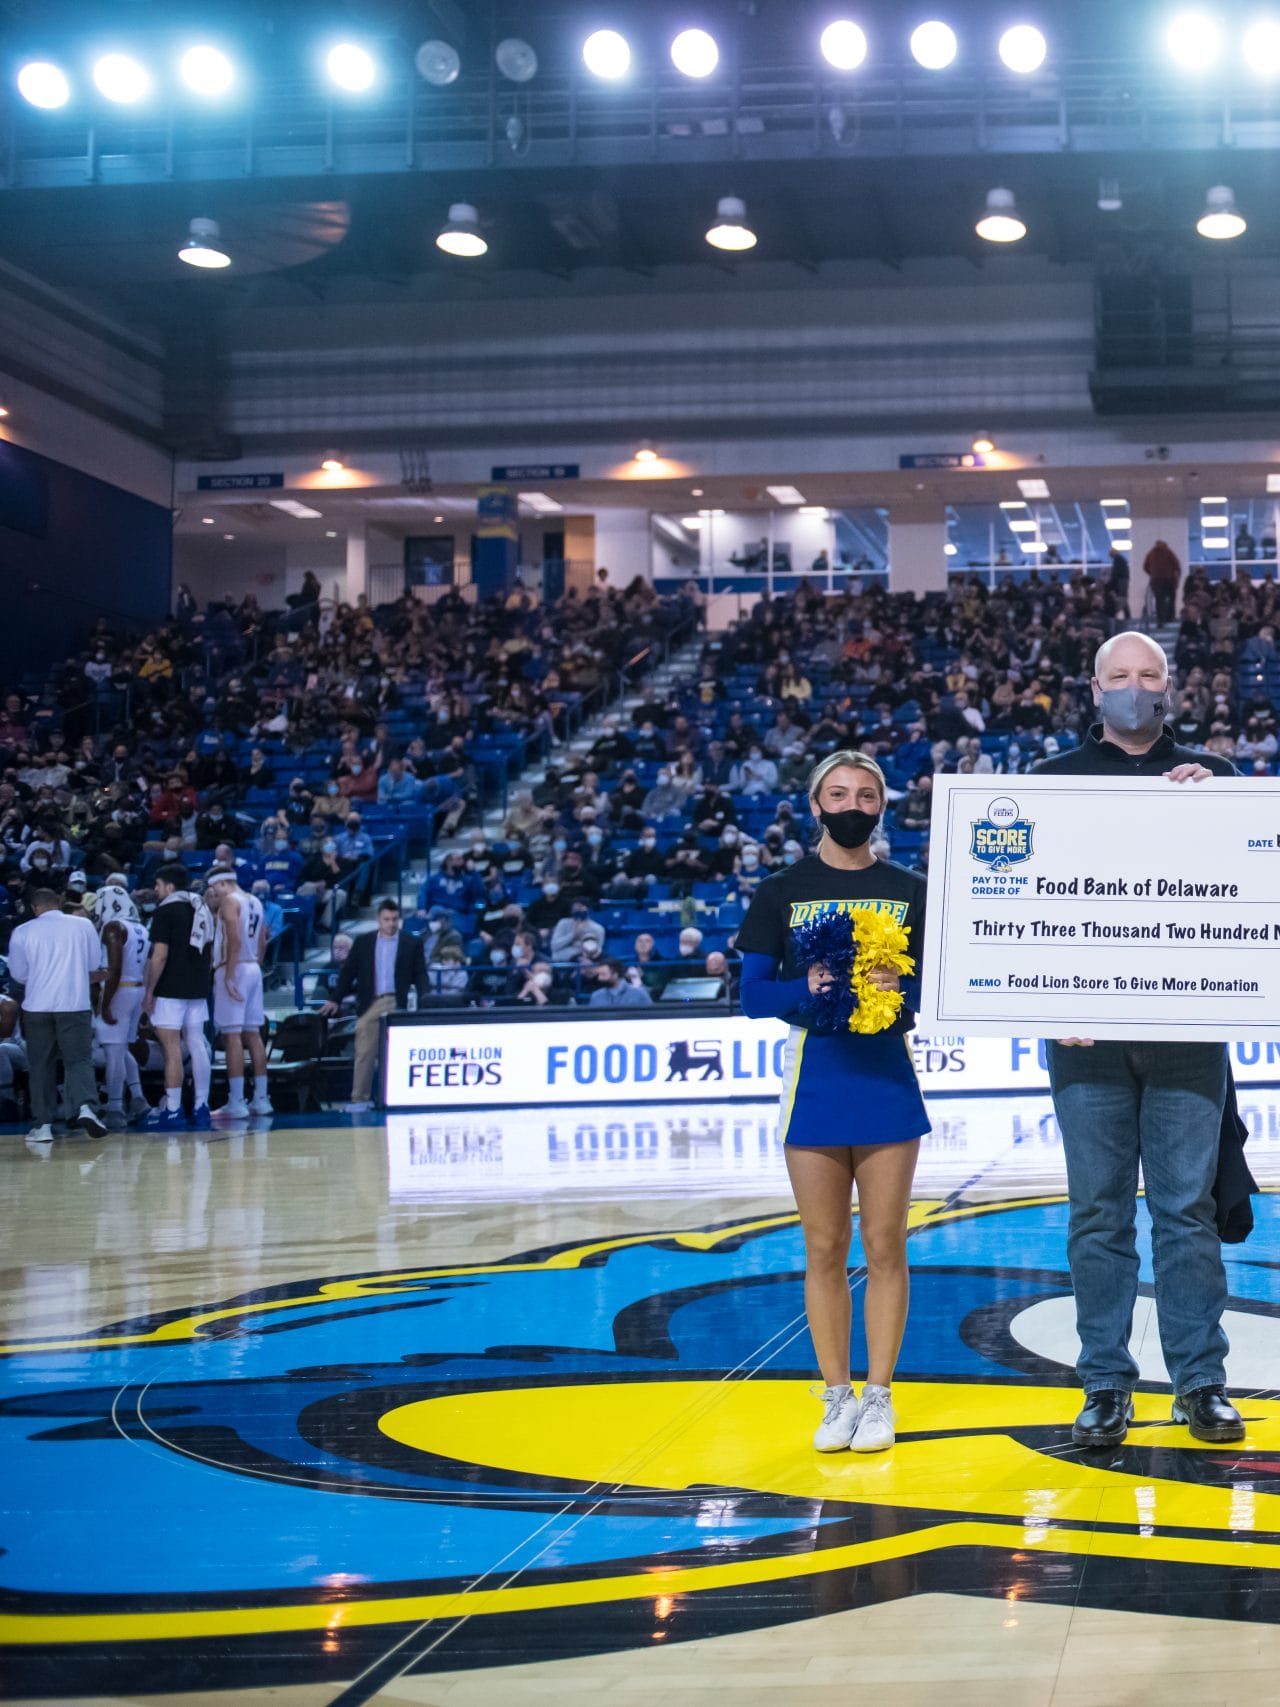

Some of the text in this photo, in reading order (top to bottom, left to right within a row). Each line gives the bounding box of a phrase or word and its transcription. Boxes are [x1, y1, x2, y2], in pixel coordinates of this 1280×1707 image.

[976, 828, 1027, 846] SCORE
[1247, 839, 1273, 848] DATE
[977, 845, 1027, 854] TO GIVE MORE
[972, 876, 1029, 885] PAY TO THE
[1036, 876, 1239, 898] Food Bank of Delaware
[971, 887, 1021, 895] ORDER OF
[972, 919, 1026, 940] Thirty
[1030, 920, 1077, 938] Three
[1081, 921, 1161, 939] Thousand
[1165, 922, 1196, 940] Two
[1200, 923, 1269, 941] Hundred
[969, 974, 1259, 992] MEMO Food Lion Score To Give More Donation
[409, 1046, 503, 1061] FOOD LION
[547, 1038, 788, 1085] FOOD LIO
[408, 1062, 503, 1088] FEEDS
